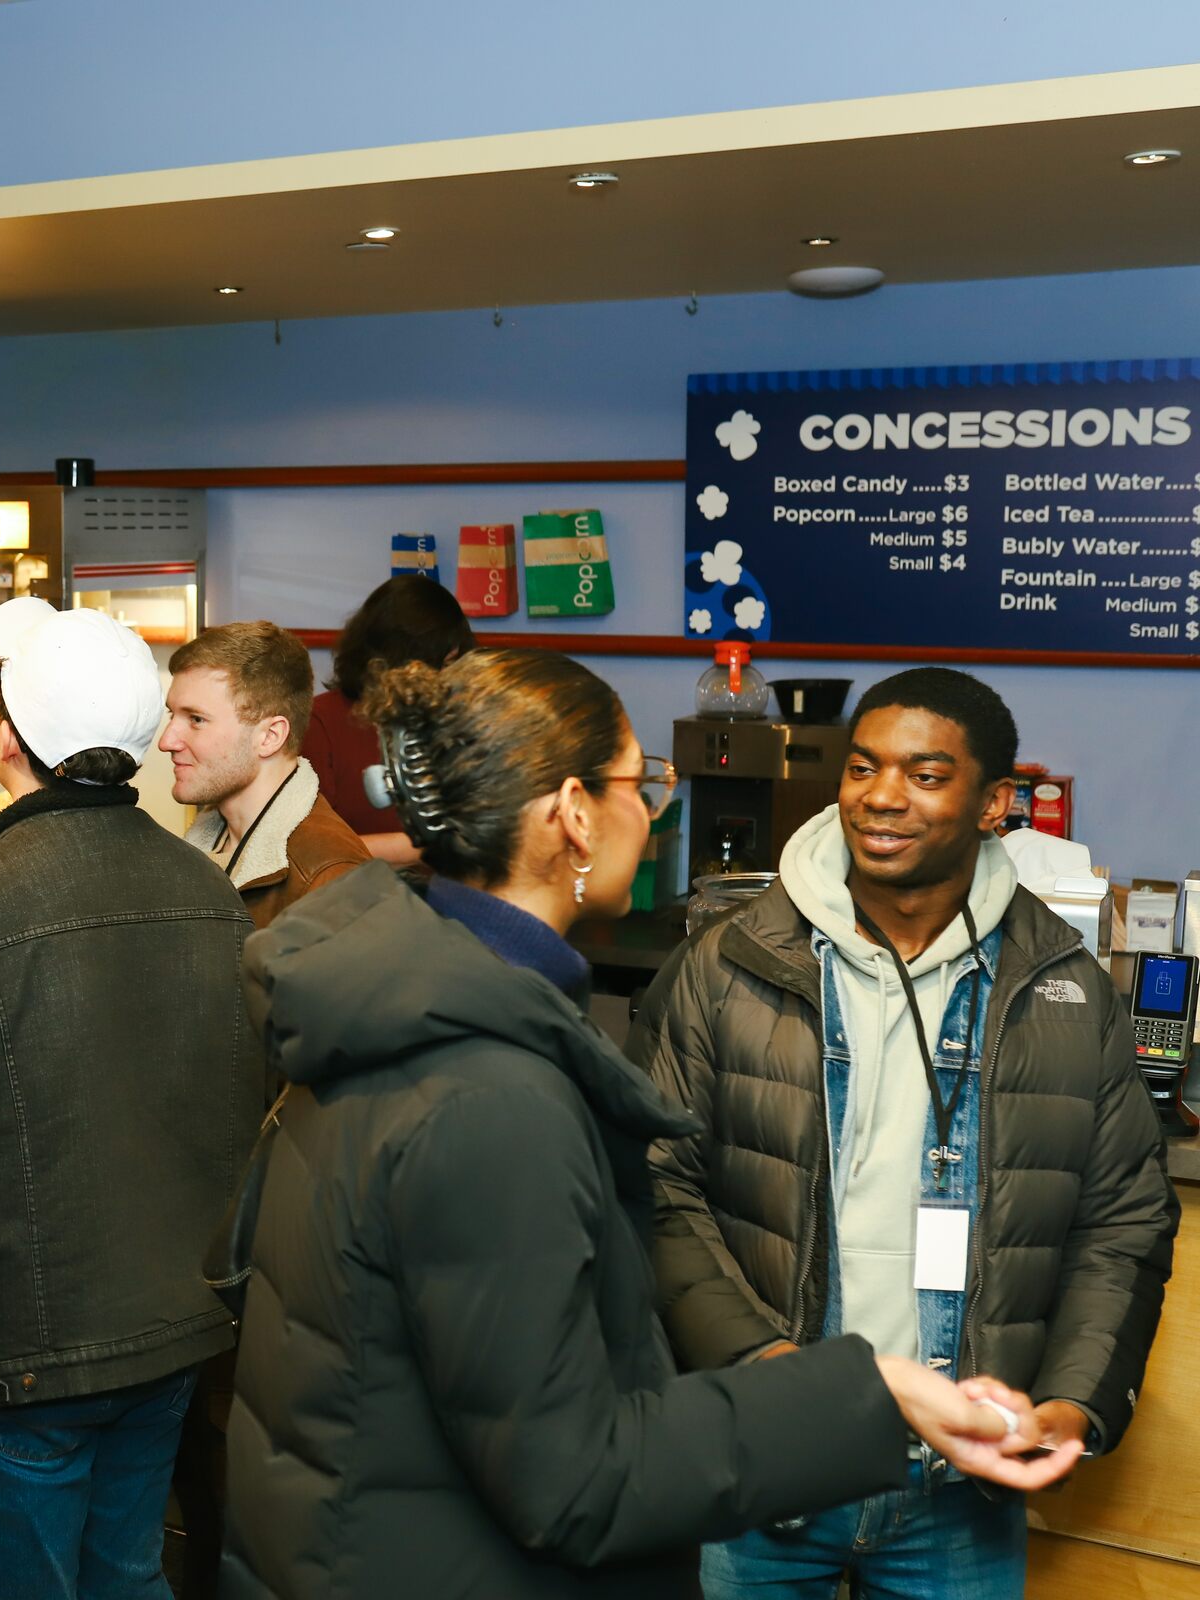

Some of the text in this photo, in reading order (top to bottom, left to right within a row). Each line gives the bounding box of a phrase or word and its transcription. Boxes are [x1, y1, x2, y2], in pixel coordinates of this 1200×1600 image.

[800, 406, 1191, 451] CONCESSIONS
[774, 475, 836, 493] Boxed
[843, 475, 907, 495] Candy
[1005, 472, 1087, 491] Bottled
[773, 506, 856, 525] Popcorn
[942, 505, 968, 524] $6
[1004, 505, 1050, 523] Iced
[1057, 506, 1095, 523] Tea
[870, 529, 967, 548] Medium $5
[1002, 537, 1065, 558] Bubly
[889, 553, 966, 572] Small $4
[1001, 568, 1097, 587] Fountain
[1000, 593, 1057, 611] Drink
[1106, 598, 1177, 613] Medium
[1129, 622, 1179, 638] Small
[1034, 986, 1066, 995] NORTH
[1045, 994, 1071, 1002] FACE
